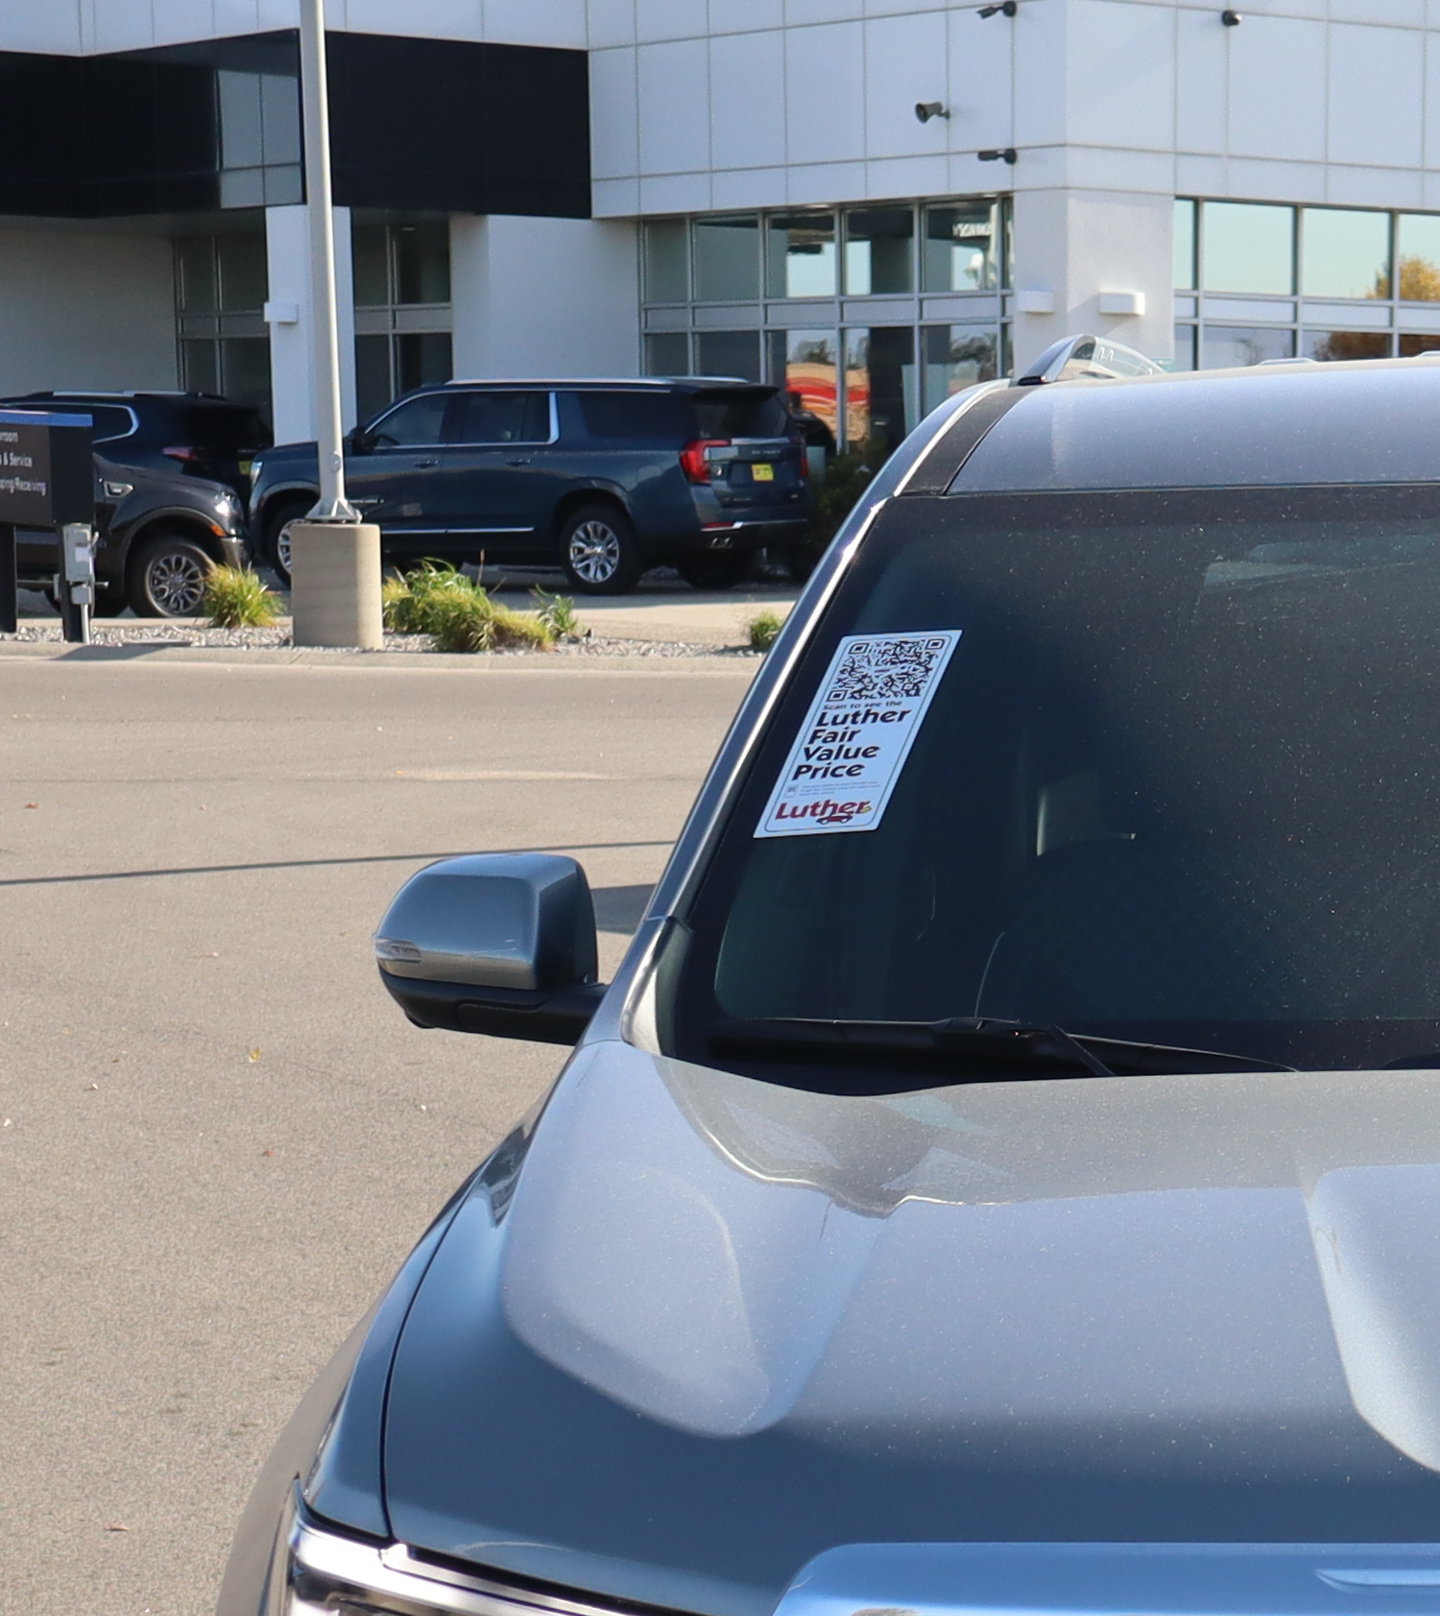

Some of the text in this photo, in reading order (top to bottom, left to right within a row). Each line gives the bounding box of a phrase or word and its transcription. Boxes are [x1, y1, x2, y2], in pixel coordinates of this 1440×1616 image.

[815, 708, 912, 727] Luther
[807, 727, 862, 745] Fair
[803, 744, 881, 762] Value
[791, 761, 865, 780] Price
[774, 799, 871, 820] Luther
